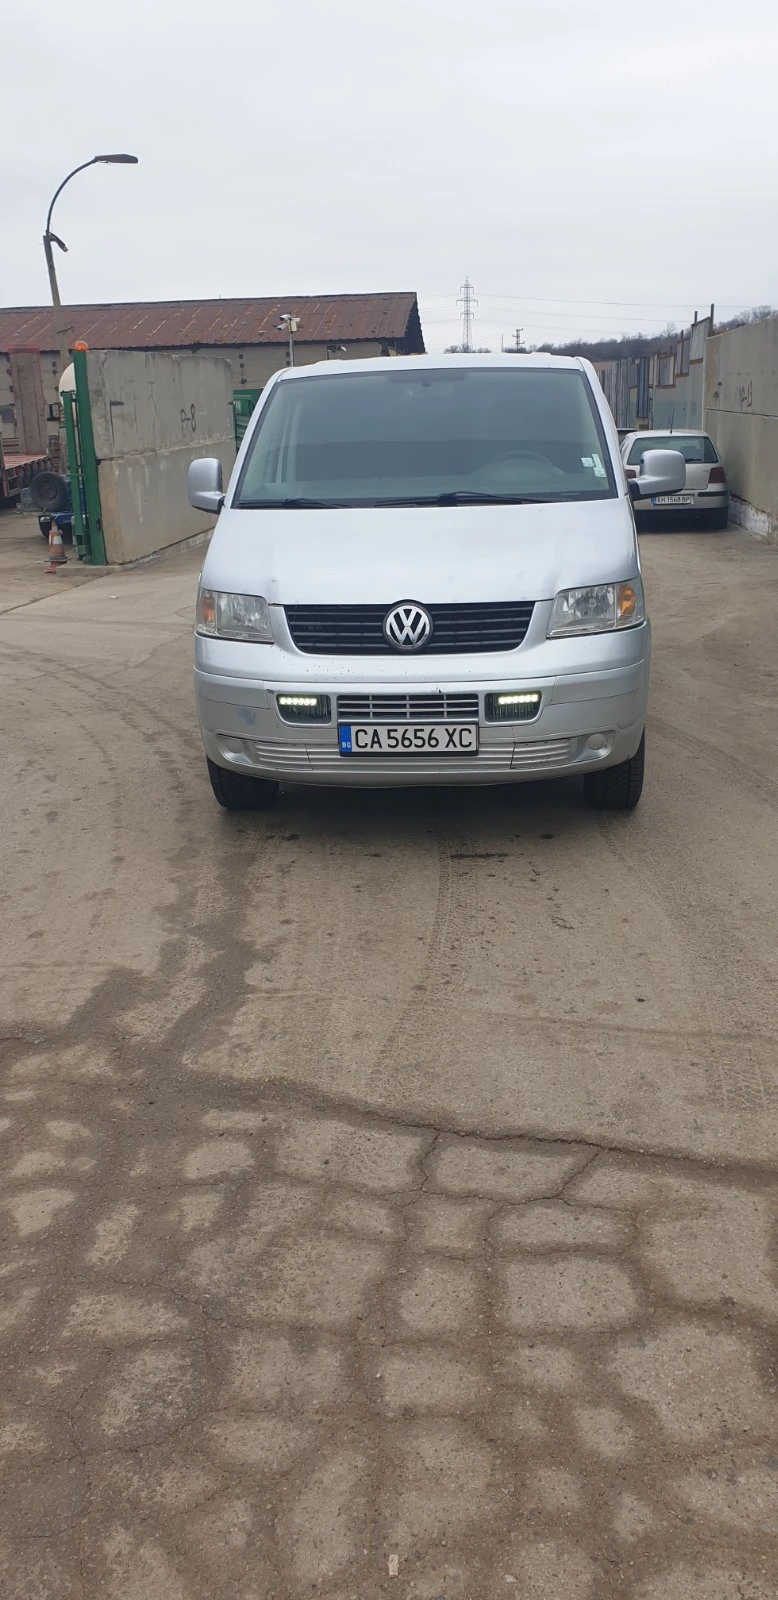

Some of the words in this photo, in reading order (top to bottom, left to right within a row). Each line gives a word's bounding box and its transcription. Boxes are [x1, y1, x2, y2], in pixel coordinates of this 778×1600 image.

[385, 604, 430, 650] VW
[341, 741, 352, 749] BG
[354, 728, 383, 749] CA
[386, 728, 440, 749] 5656
[444, 727, 473, 749] XC
